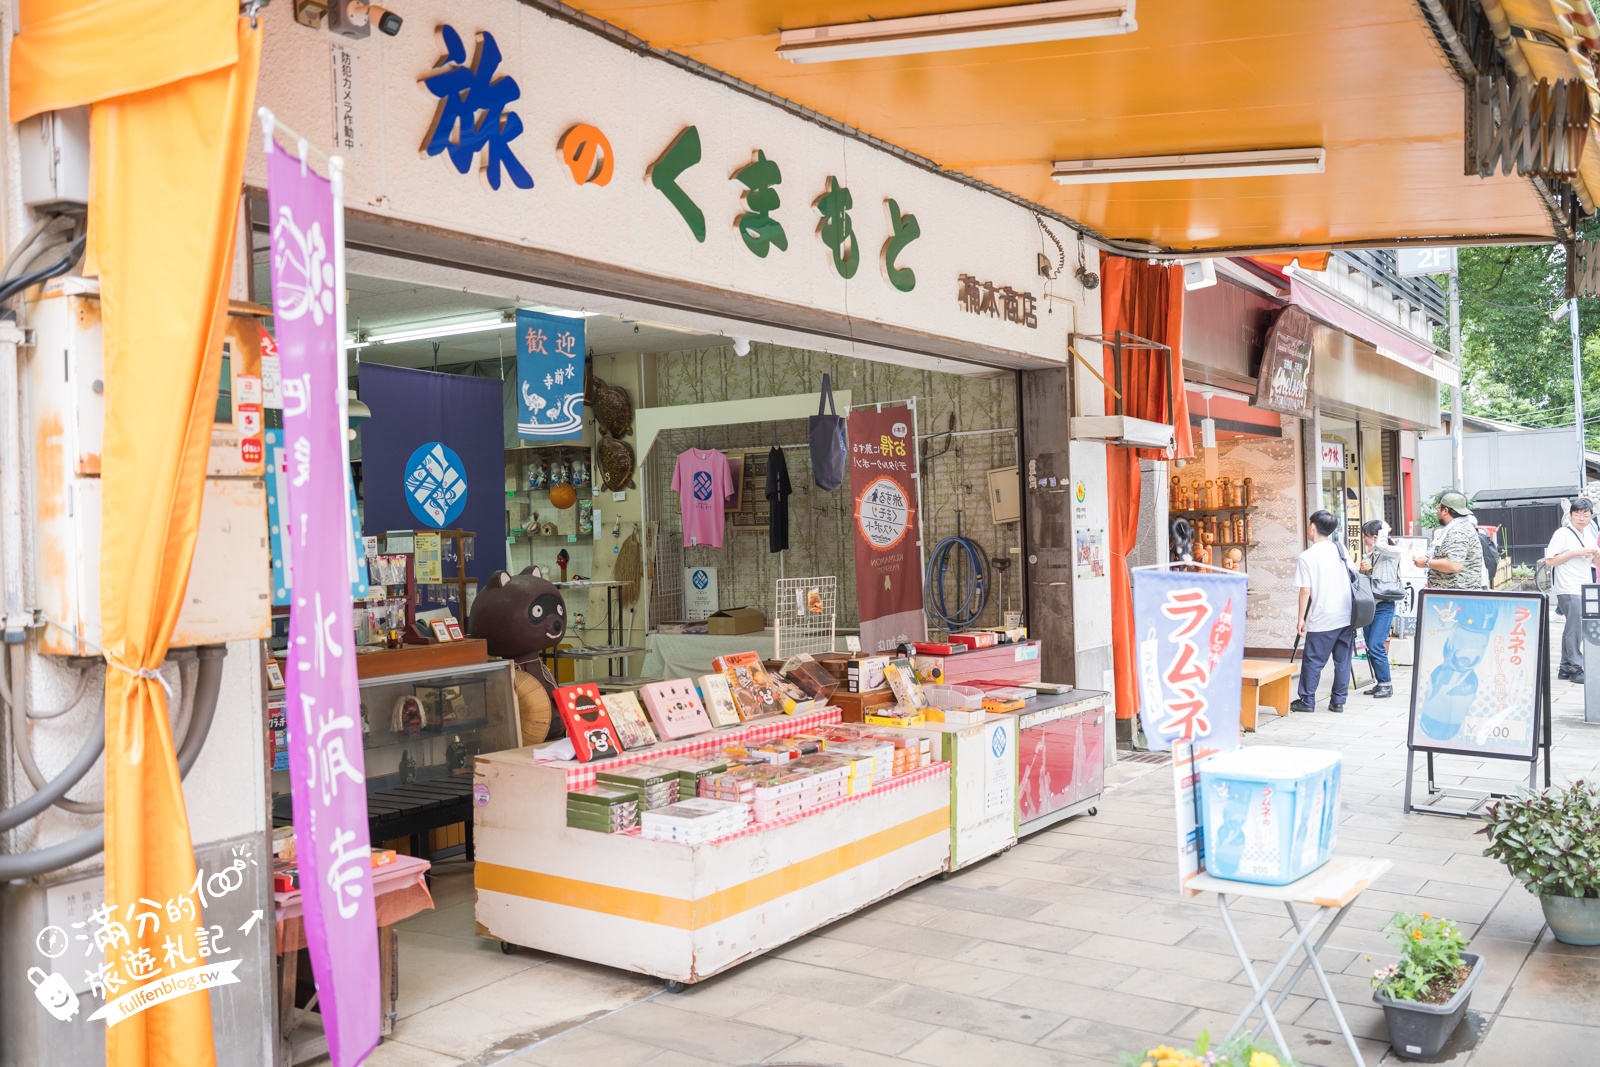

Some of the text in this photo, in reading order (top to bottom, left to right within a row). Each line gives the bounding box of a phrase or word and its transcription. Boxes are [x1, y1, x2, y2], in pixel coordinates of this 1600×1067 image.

[341, 51, 354, 150] 防犯カメラ作動中
[421, 24, 921, 293] 旅のくまもと
[1417, 247, 1448, 268] 2F
[525, 327, 576, 358] 歓迎
[543, 363, 575, 390] 水前寺
[1507, 605, 1532, 666] ラムネの
[1160, 589, 1211, 741] ラムネ
[1261, 786, 1272, 825] ラムネの
[1253, 866, 1269, 874] 200
